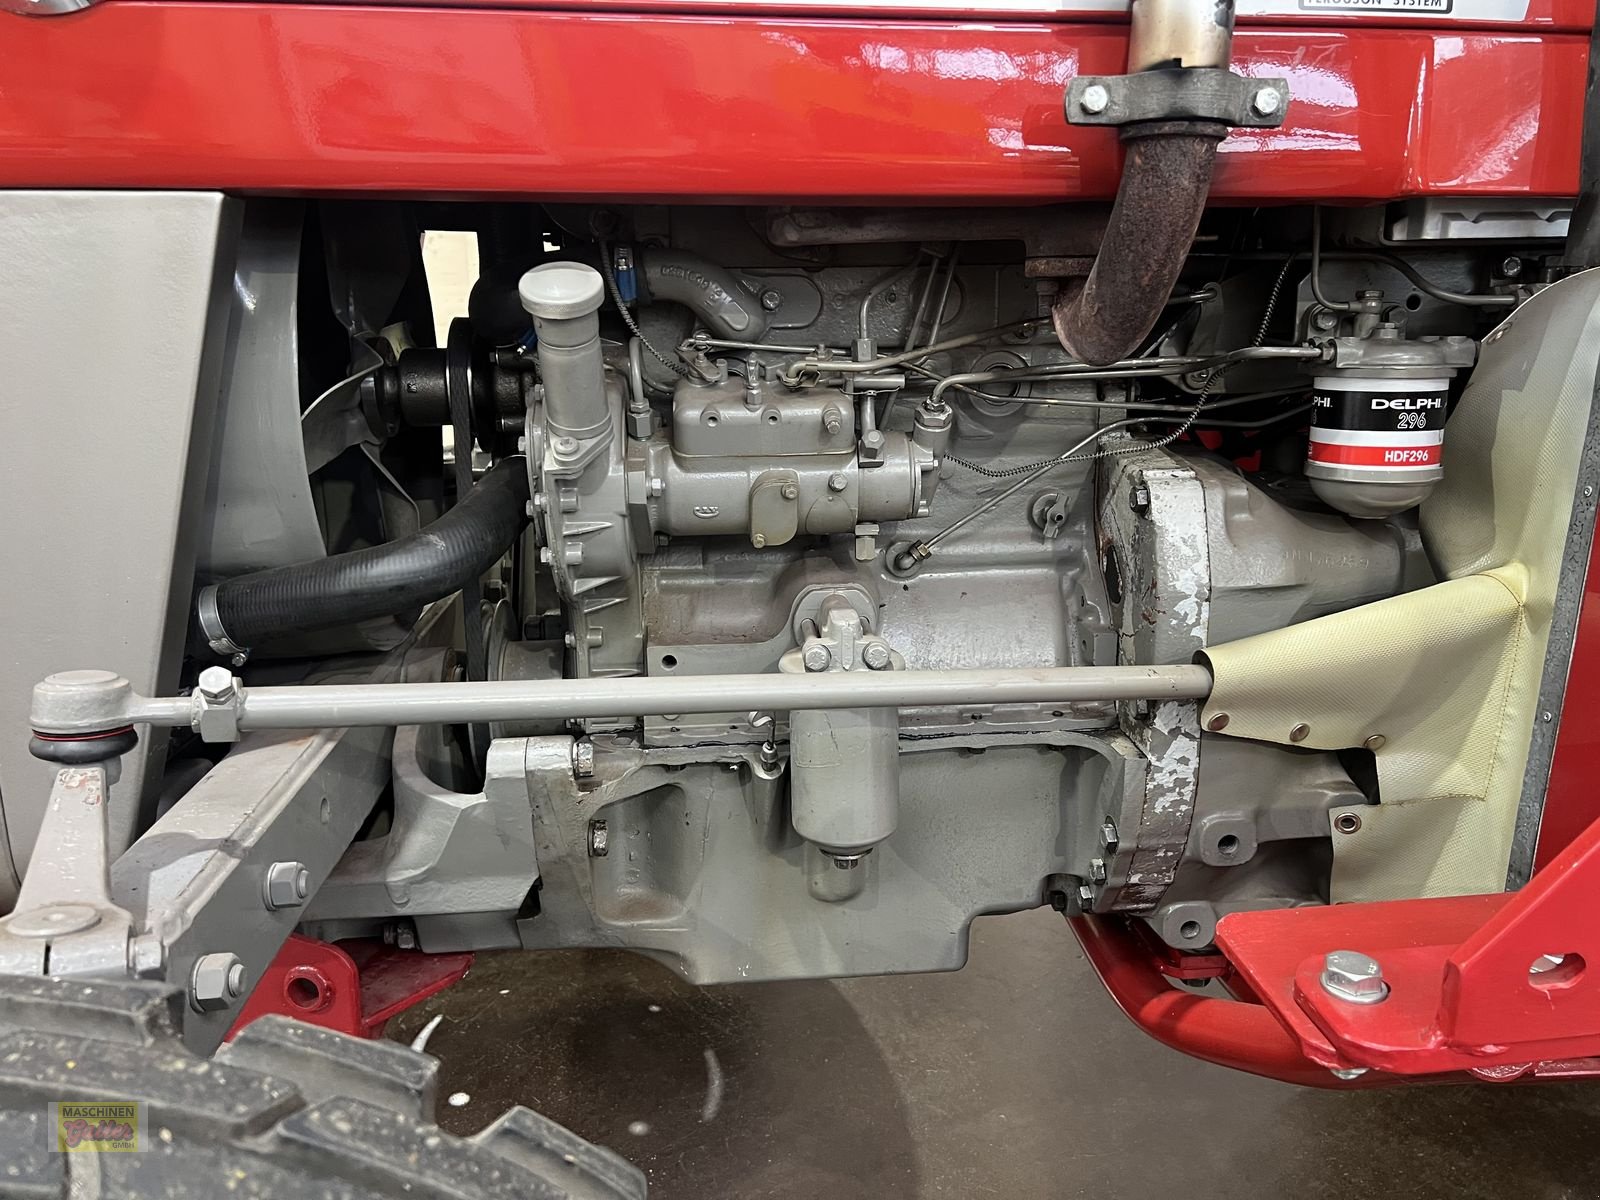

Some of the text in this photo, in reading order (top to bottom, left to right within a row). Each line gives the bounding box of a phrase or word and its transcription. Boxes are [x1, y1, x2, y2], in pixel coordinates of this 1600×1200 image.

[1371, 398, 1442, 410] DELPHI
[1397, 412, 1427, 429] 296
[1384, 450, 1429, 463] HDF296
